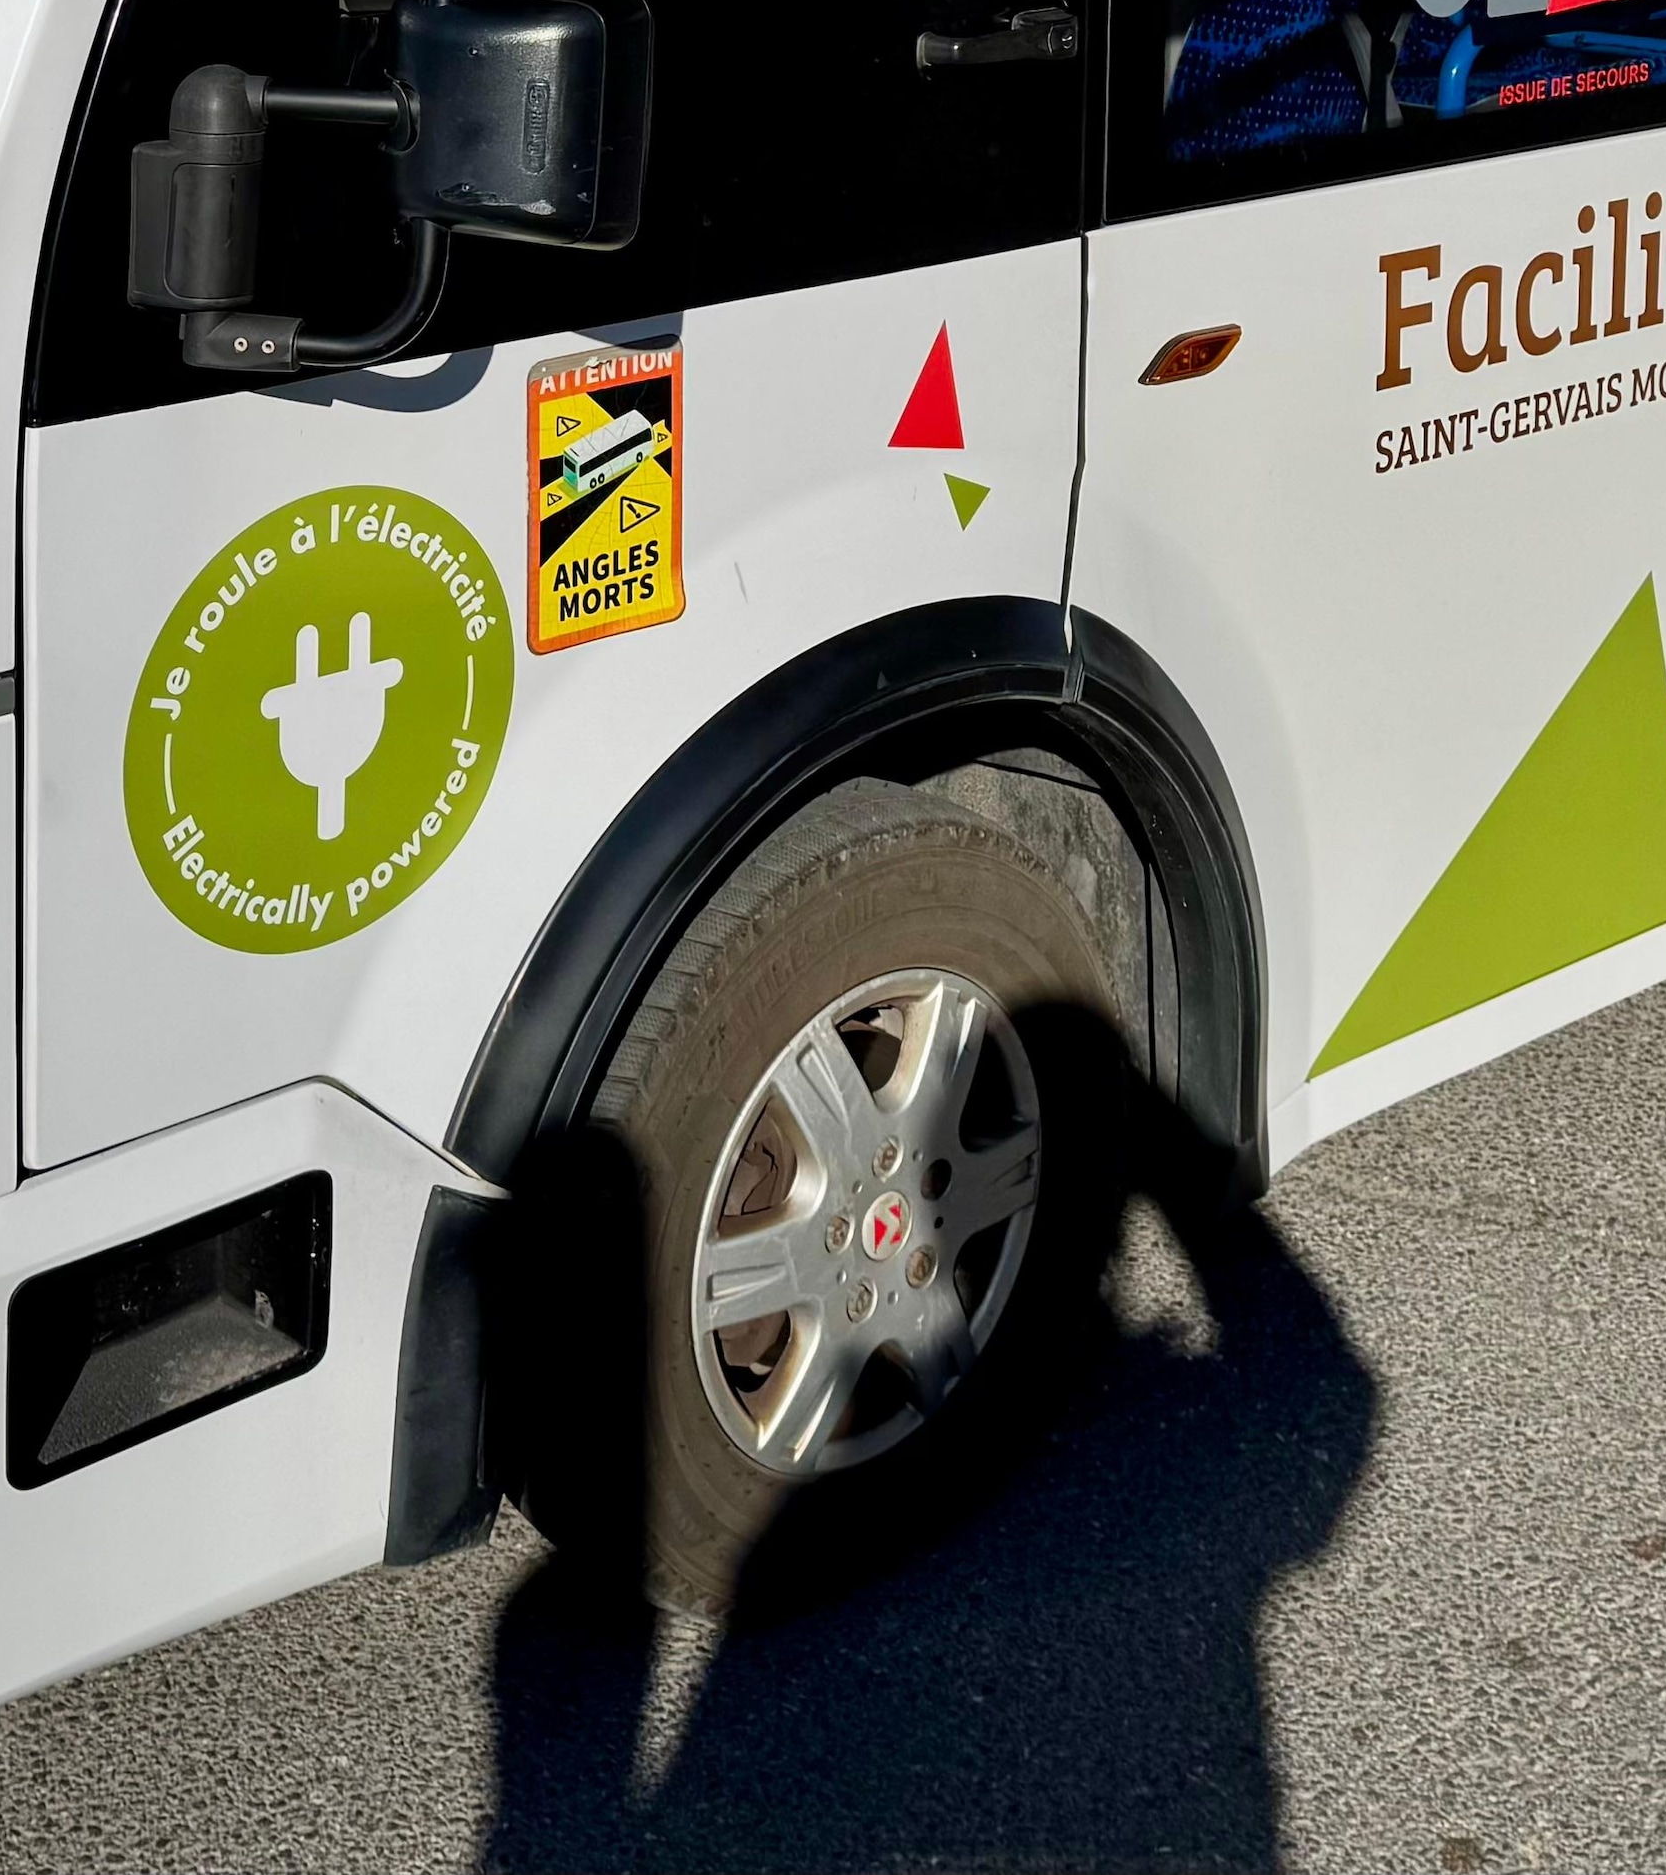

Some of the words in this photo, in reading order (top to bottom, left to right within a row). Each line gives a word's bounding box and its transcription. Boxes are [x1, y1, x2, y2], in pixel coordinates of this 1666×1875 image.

[1499, 79, 1547, 105] ISSUE
[1551, 75, 1573, 97] DE
[1576, 63, 1649, 93] SECOURS
[539, 351, 673, 395] ATTENTION
[1375, 373, 1623, 475] SAINT-GERVAIS
[553, 539, 659, 592] ANGLES
[150, 665, 192, 721] Je
[183, 547, 278, 655] roule
[289, 516, 318, 555] à
[559, 573, 655, 623] MORTS
[162, 814, 334, 932] Electrically
[345, 737, 481, 917] powered
